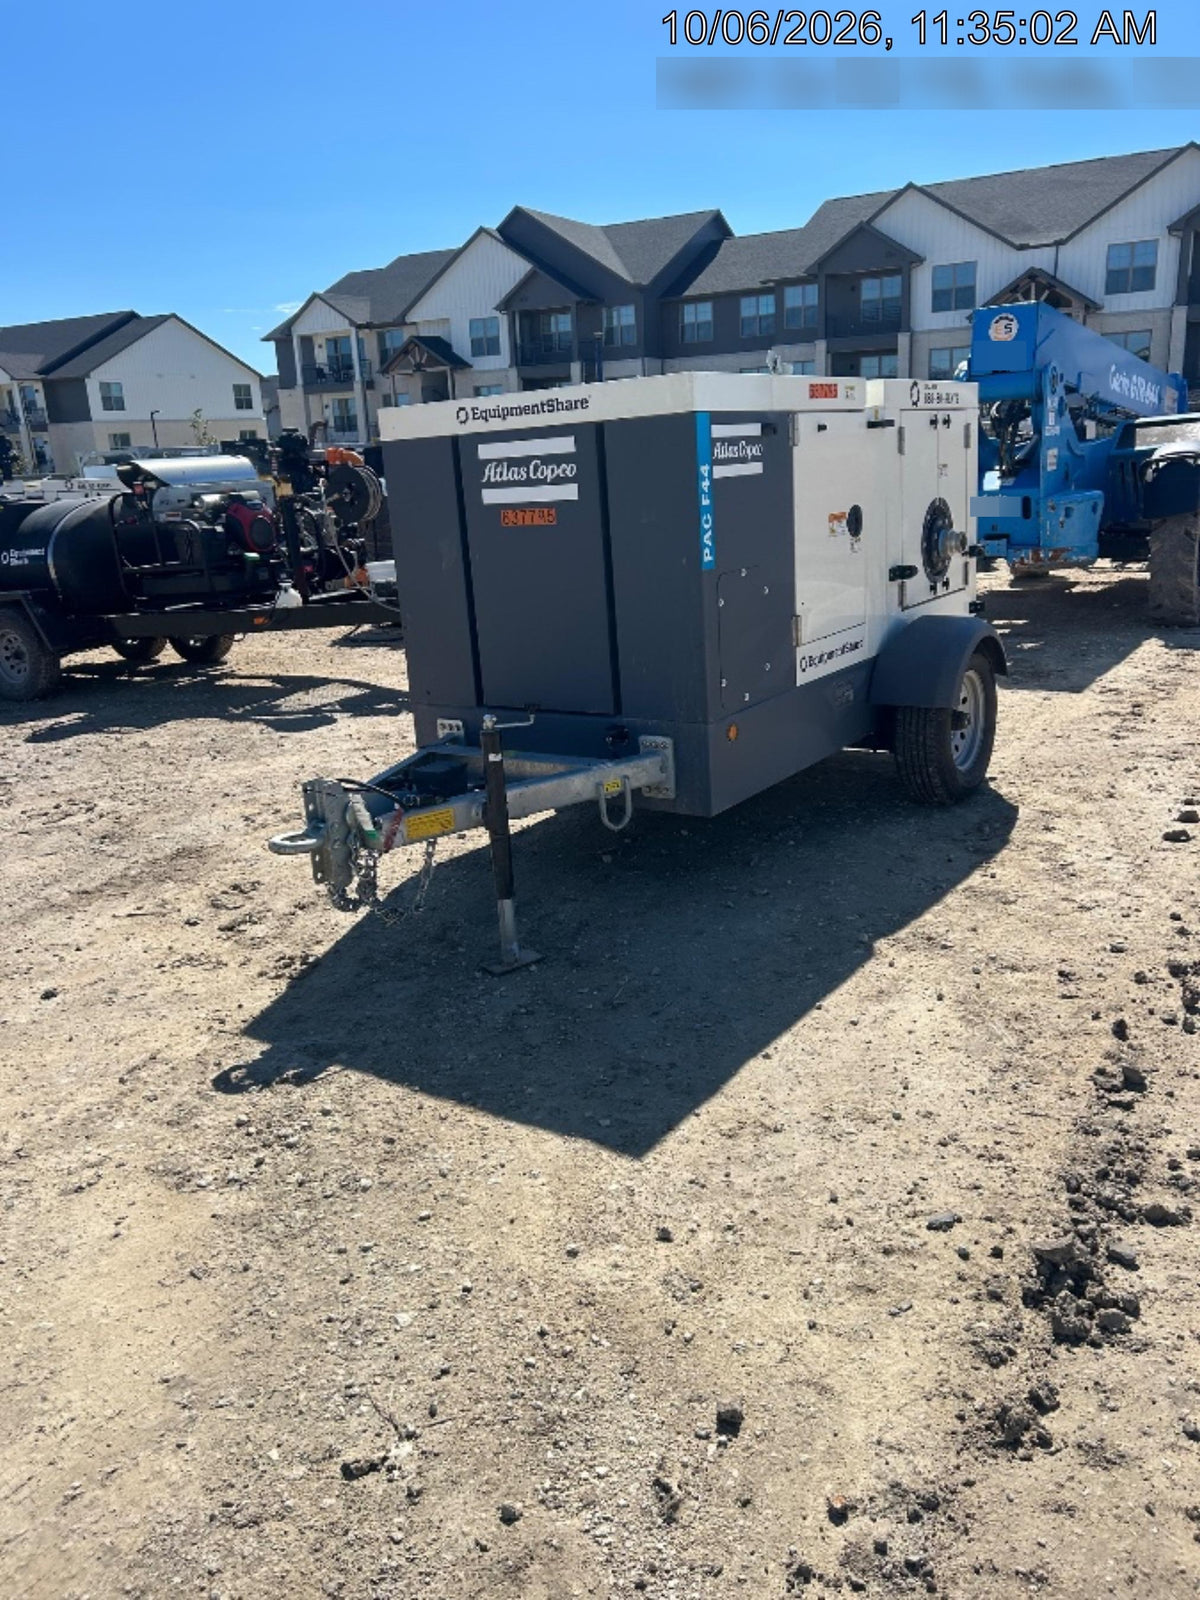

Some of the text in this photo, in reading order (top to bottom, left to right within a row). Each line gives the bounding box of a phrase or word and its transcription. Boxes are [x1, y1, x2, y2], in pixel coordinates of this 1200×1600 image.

[471, 397, 590, 422] EquipmentShare
[713, 441, 739, 459] Atlas
[482, 459, 577, 482] Atlas Copco
[700, 463, 713, 563] PAC F44
